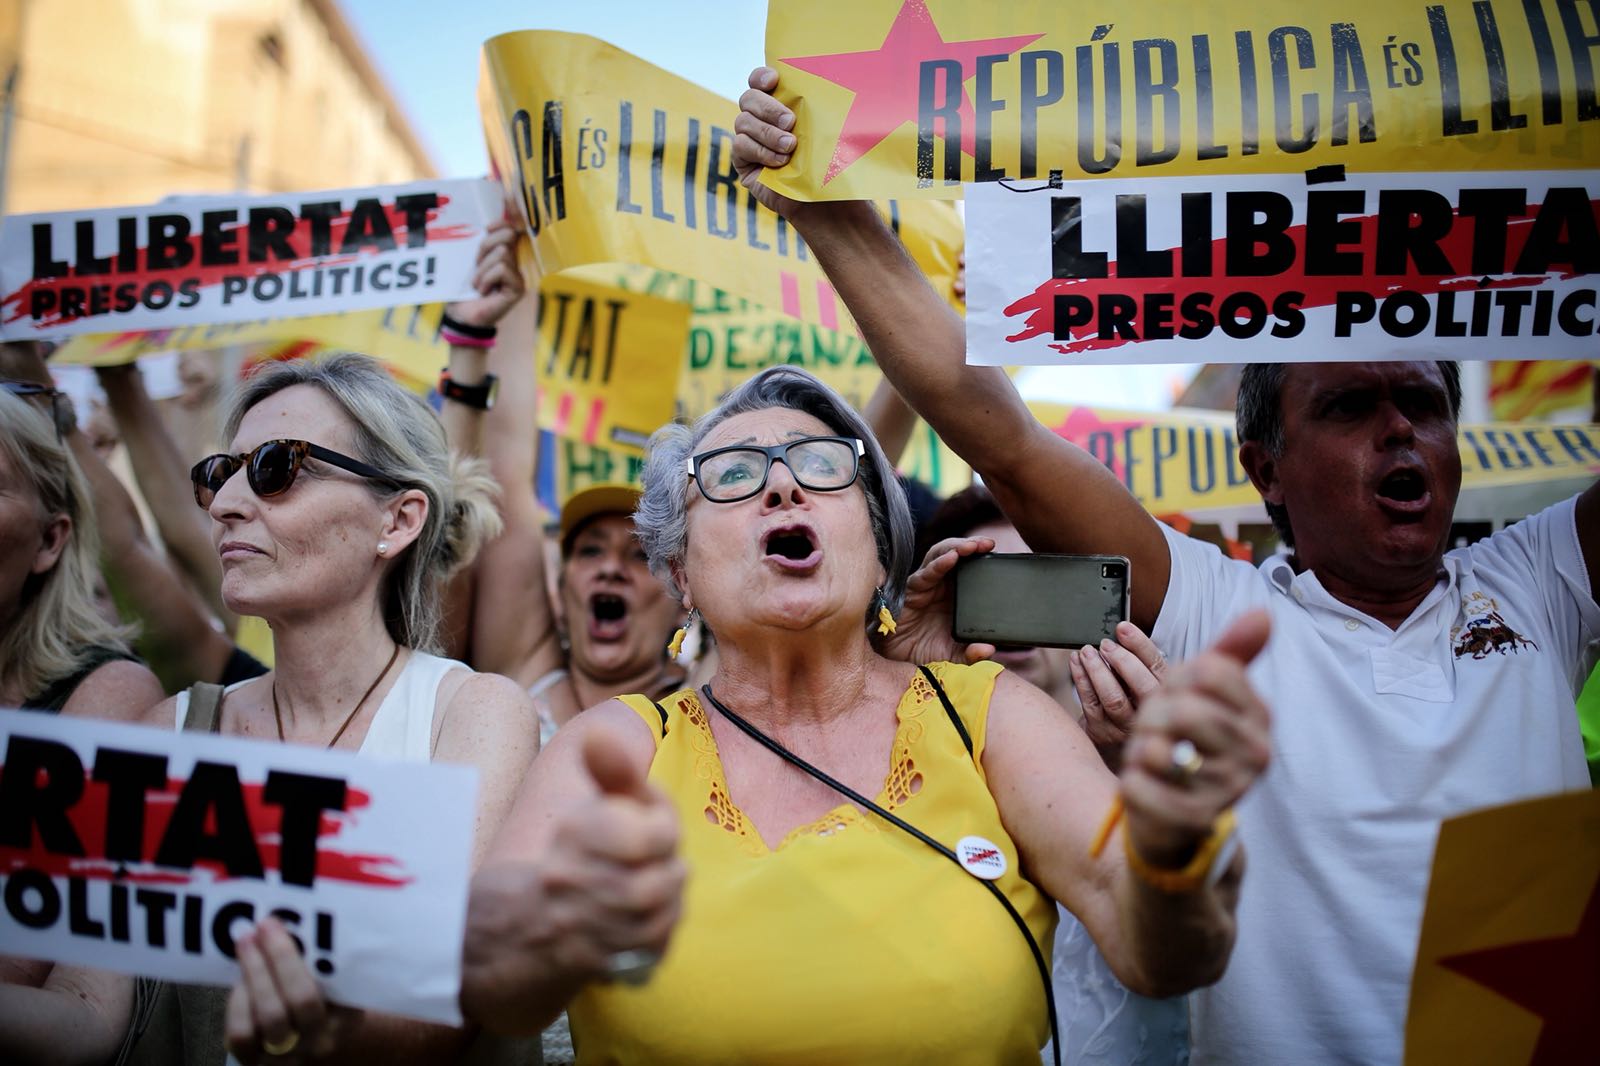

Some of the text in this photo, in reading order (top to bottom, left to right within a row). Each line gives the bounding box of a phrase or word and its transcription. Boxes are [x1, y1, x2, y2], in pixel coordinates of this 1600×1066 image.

[917, 23, 1377, 188] REPÚBLICA
[1382, 35, 1424, 89] ÉS
[577, 119, 607, 171] ÉS
[32, 192, 437, 279] LLIBERTAT
[31, 257, 436, 320] PRESOS POLÍTICS!
[1054, 276, 1600, 341] PRESOS POLÍTIC
[1462, 427, 1600, 472] IBER
[0, 733, 347, 889] RTAT
